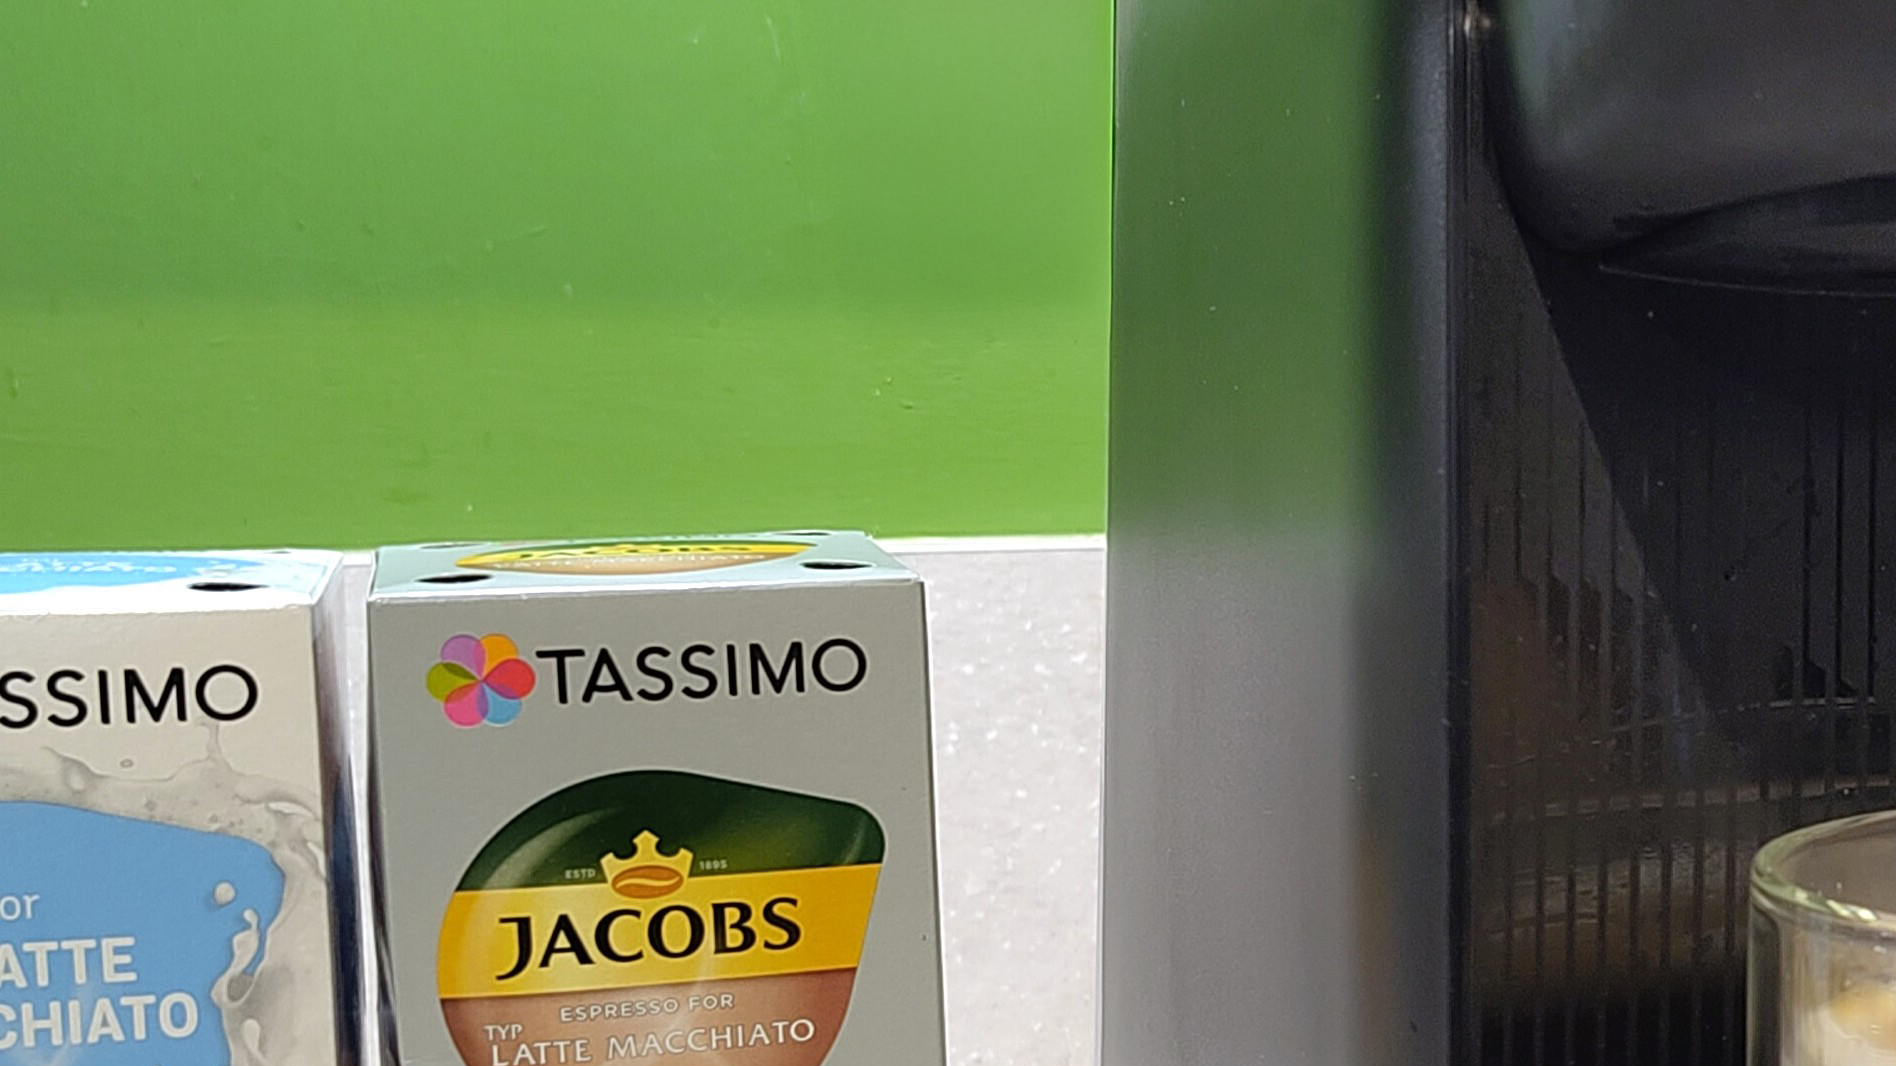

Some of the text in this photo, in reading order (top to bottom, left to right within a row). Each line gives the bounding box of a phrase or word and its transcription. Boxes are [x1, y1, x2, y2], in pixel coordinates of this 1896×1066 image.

[536, 638, 867, 704] TASSIMO
[0, 664, 258, 729] SSIMO
[564, 868, 596, 880] ESTD
[0, 894, 40, 920] or
[496, 897, 801, 980] JACOBS
[0, 936, 138, 989] ATTE
[560, 993, 734, 1022] ESPRESSO FOR
[484, 1024, 522, 1042] TYP
[607, 1018, 816, 1060] MACCHIATO
